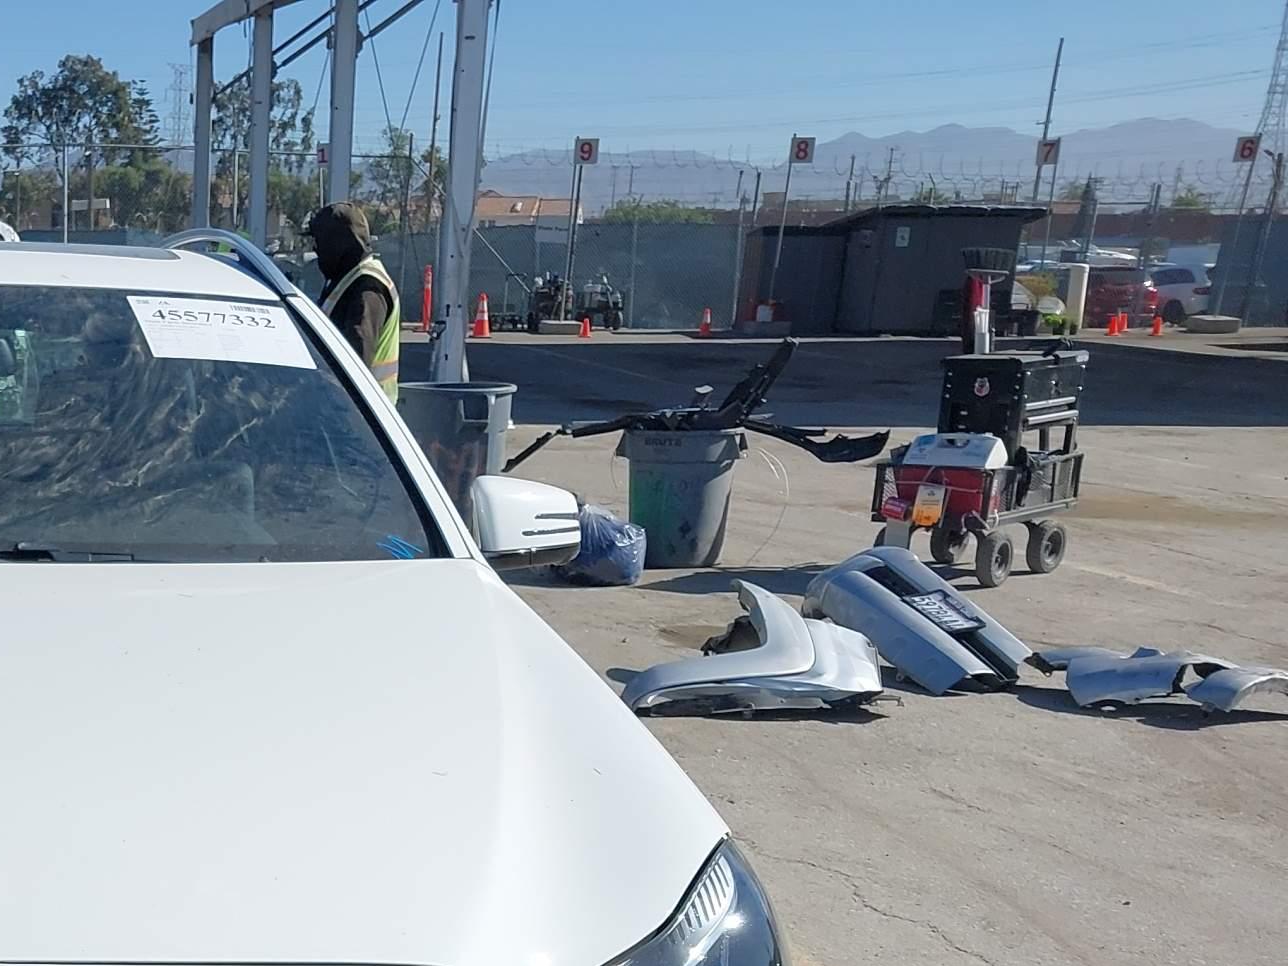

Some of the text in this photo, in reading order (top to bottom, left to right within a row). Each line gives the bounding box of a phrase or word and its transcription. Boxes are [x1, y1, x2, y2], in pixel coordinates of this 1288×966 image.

[580, 141, 593, 162] 9
[795, 140, 809, 160] 8
[1043, 142, 1056, 162] 7
[1240, 139, 1255, 159] 6
[152, 309, 276, 329] 45577332
